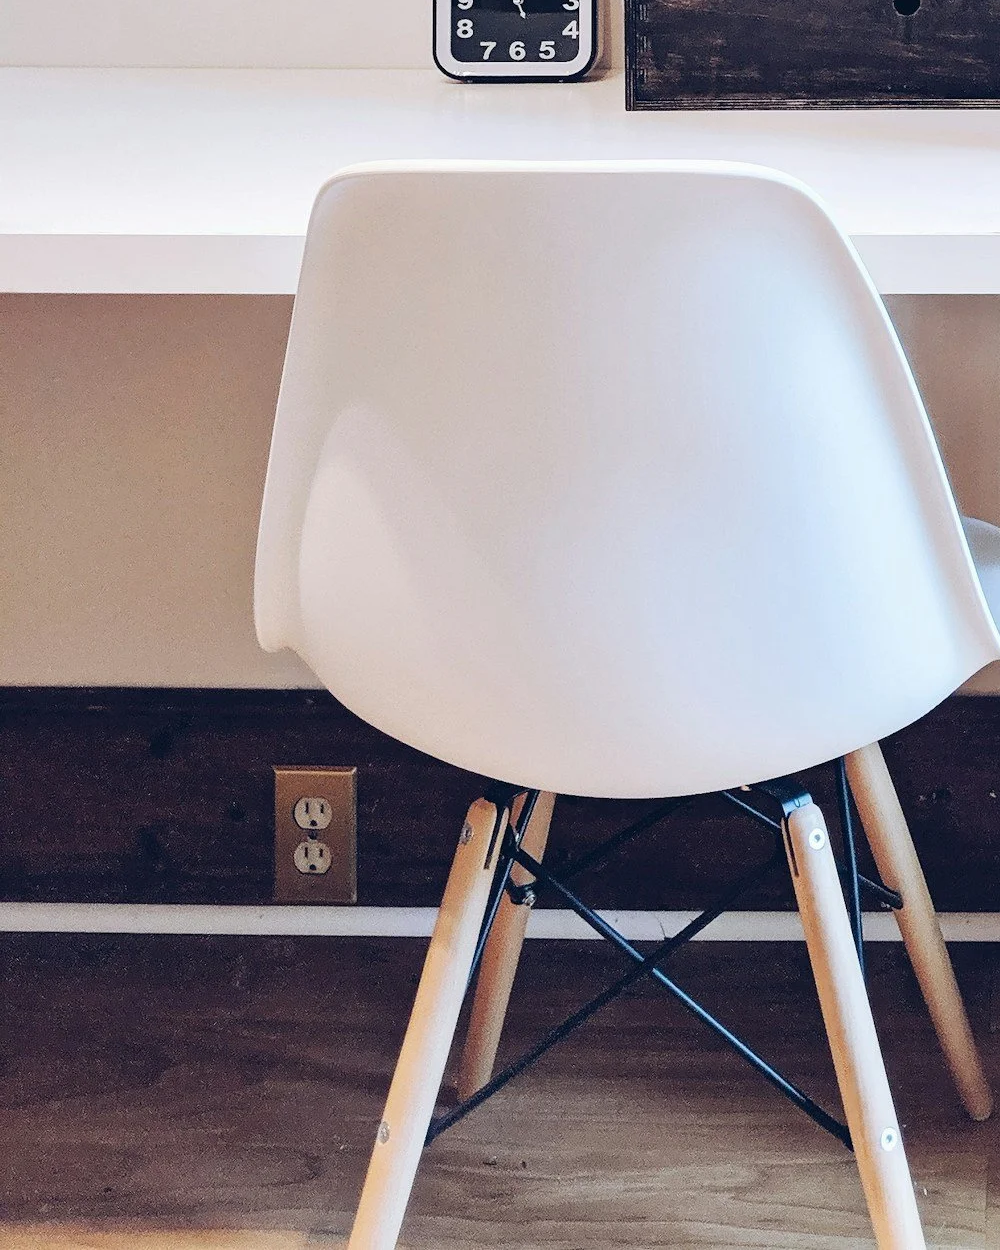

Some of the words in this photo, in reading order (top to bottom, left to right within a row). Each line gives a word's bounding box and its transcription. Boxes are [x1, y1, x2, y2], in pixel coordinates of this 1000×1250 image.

[456, 18, 474, 39] 8
[562, 20, 580, 40] 4
[479, 40, 497, 60] 7
[508, 40, 526, 61] 6
[538, 40, 556, 60] 5
